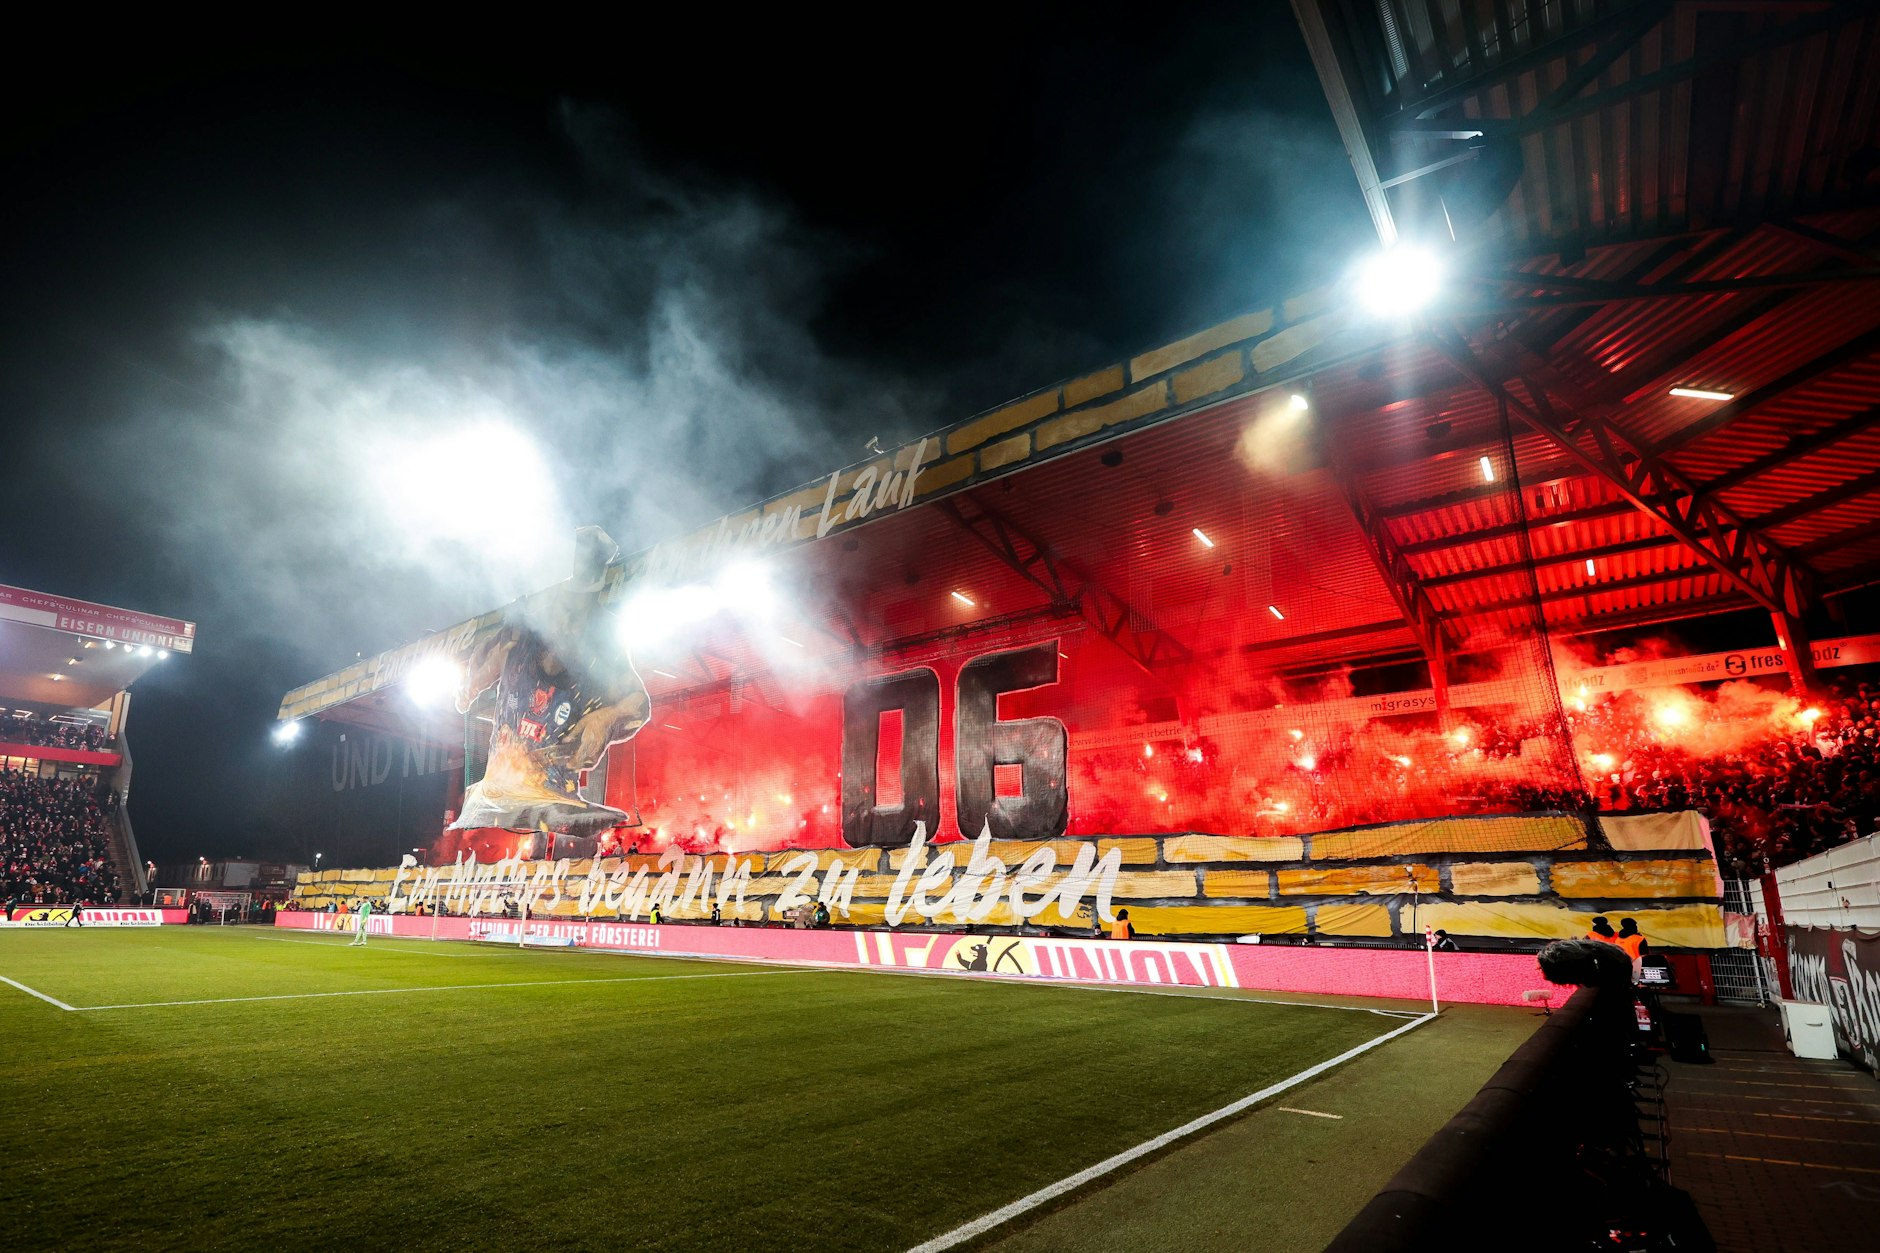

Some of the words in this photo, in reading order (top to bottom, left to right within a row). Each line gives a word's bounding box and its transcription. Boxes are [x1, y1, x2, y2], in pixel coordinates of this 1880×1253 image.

[816, 438, 927, 538] Lauf
[60, 616, 115, 637] EISERN
[121, 628, 174, 648] UNION!
[1370, 696, 1436, 712] migrasys
[331, 738, 393, 792] UND
[841, 637, 1070, 849] 06
[388, 853, 439, 915] Ein
[443, 848, 571, 917] Mythos
[578, 842, 752, 921] begann
[775, 851, 860, 918] zu
[884, 813, 1122, 927] leben
[470, 921, 509, 938] STADION
[553, 925, 587, 943] ALTEN
[592, 923, 660, 948] FÖRSTEREI
